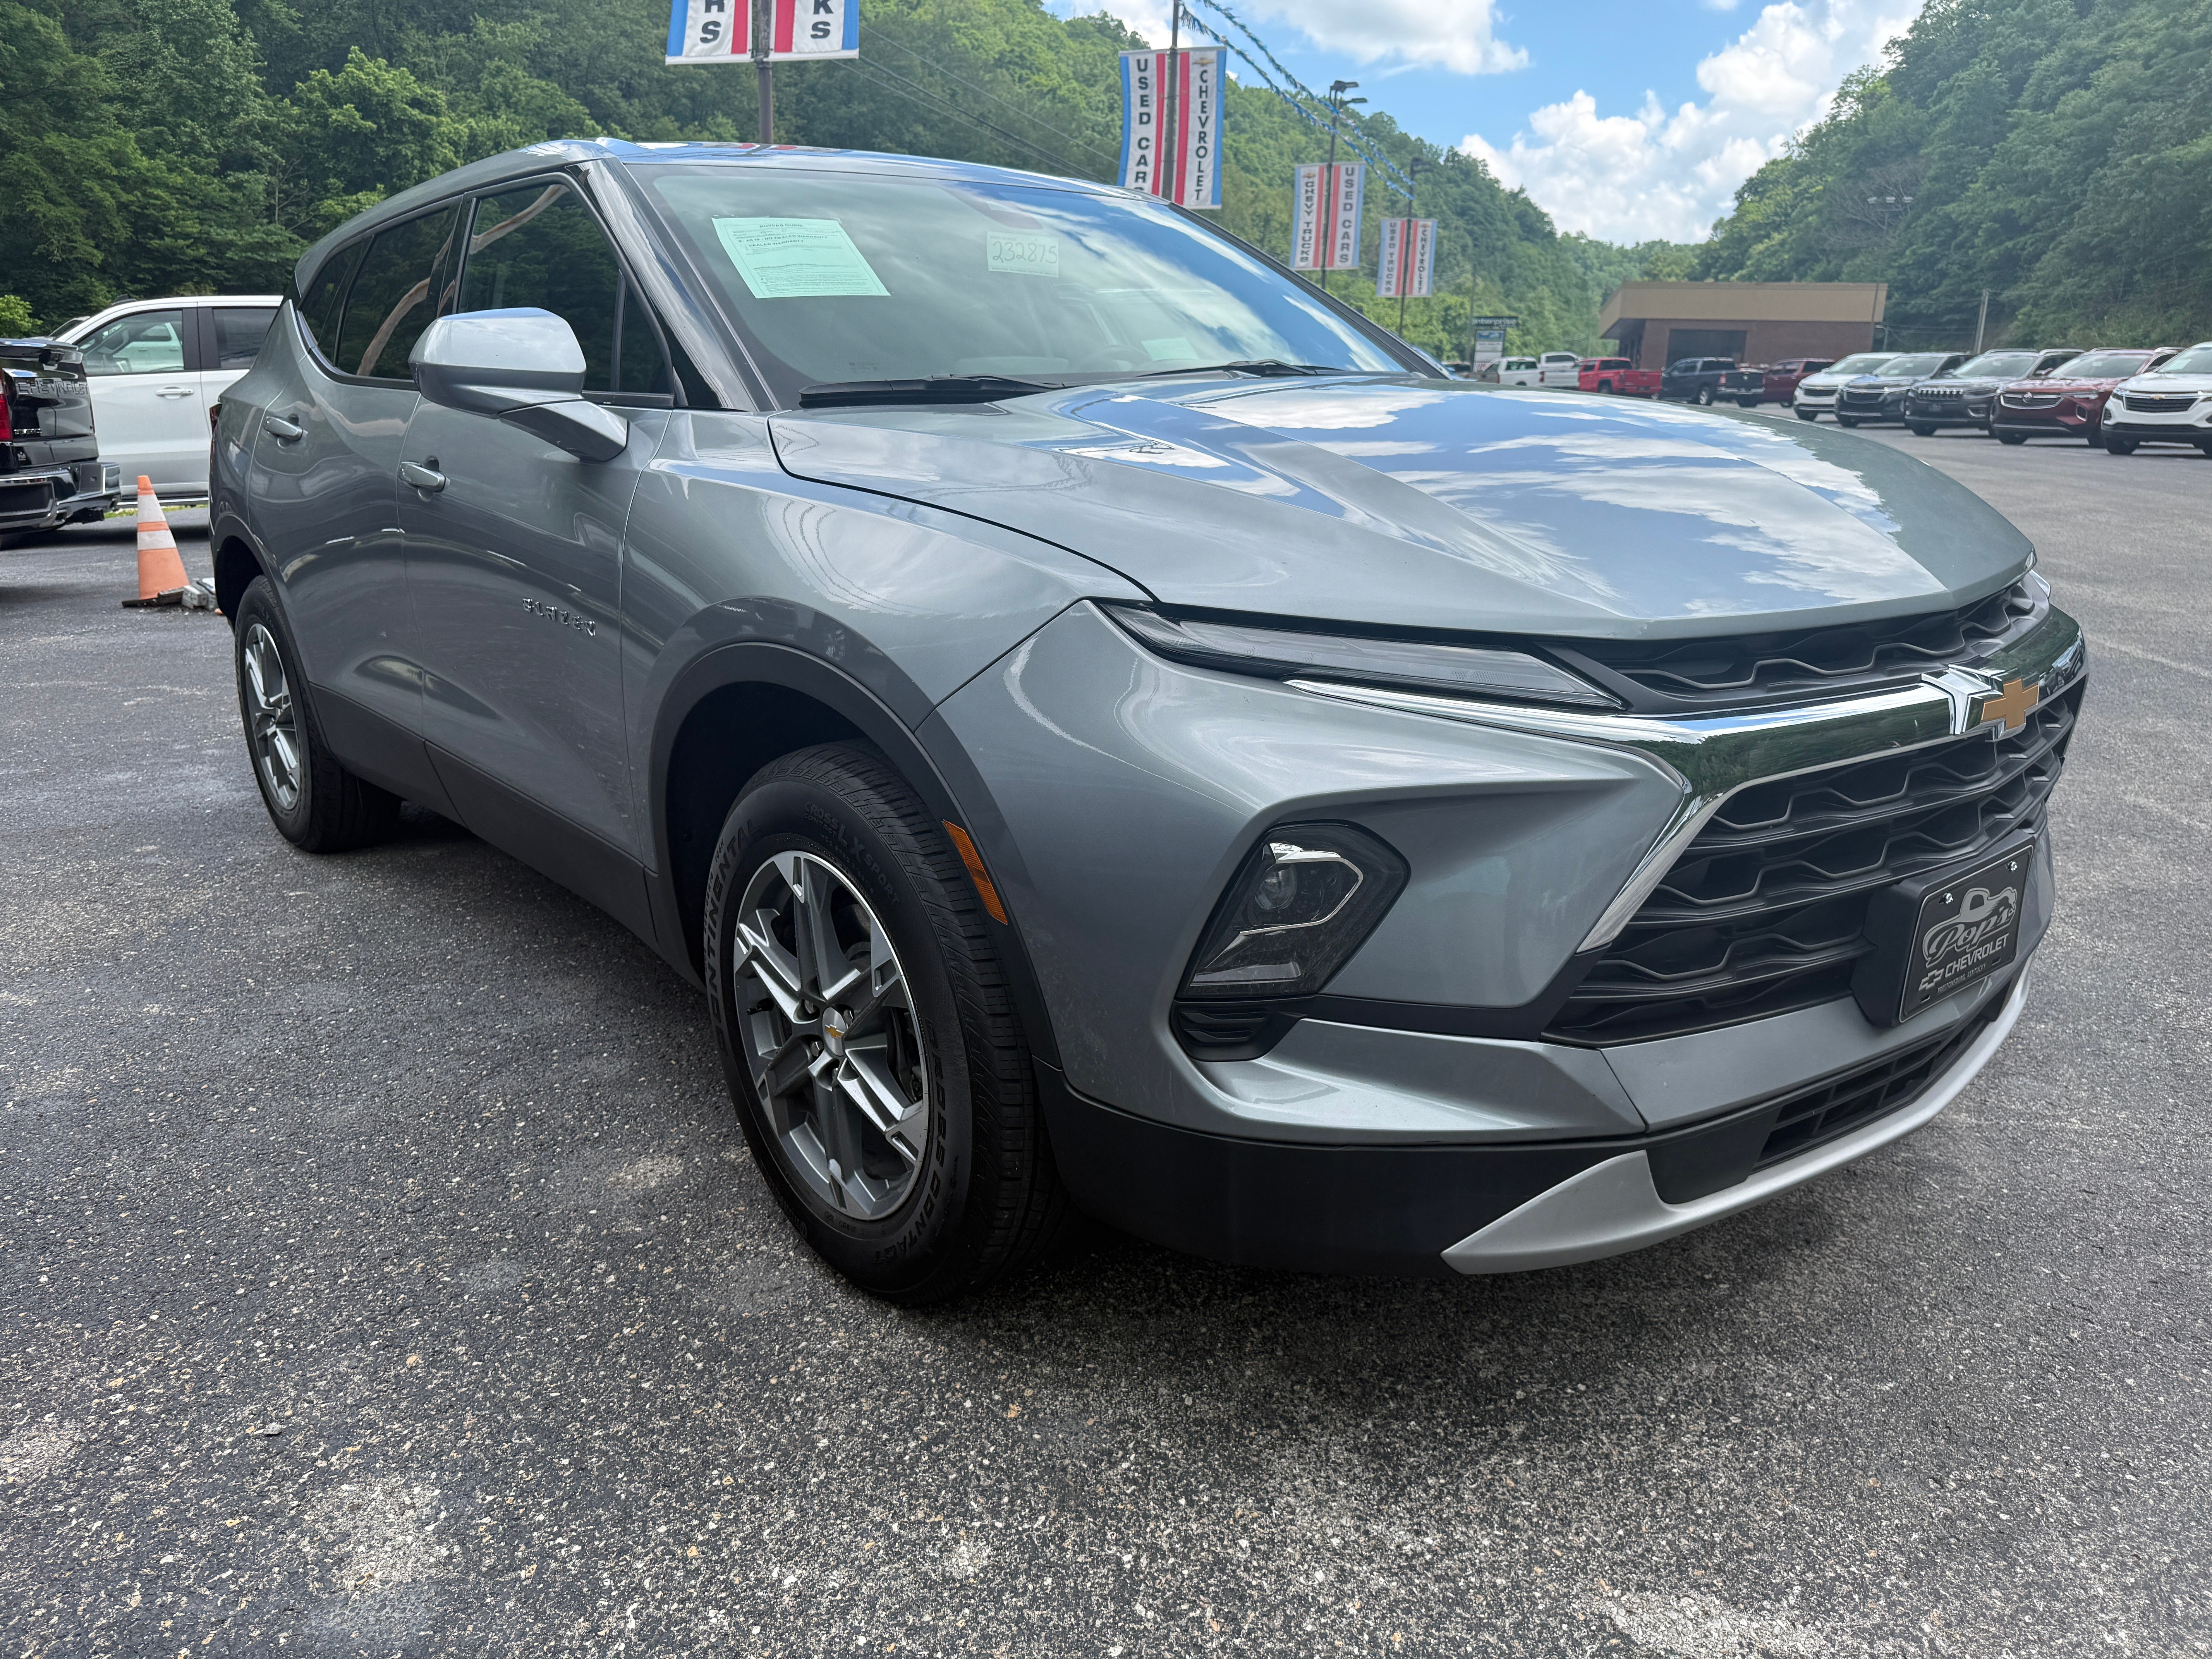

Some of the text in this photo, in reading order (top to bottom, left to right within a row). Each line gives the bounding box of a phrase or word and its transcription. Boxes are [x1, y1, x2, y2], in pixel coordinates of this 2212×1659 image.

[1133, 58, 1151, 191] USED CAR
[1194, 70, 1209, 200] CHEVROLET
[1300, 181, 1315, 262] CHEVY TRUCKS
[1339, 167, 1354, 263] USED CARS
[993, 241, 1057, 264] 232875
[1418, 229, 1427, 294] CHEVROLET
[523, 598, 596, 636] BLAZER
[805, 801, 839, 830] CROSS
[864, 853, 902, 905] SPORT
[707, 819, 761, 1055] CONTINENTAL
[1945, 933, 2009, 978] CHEVROLET
